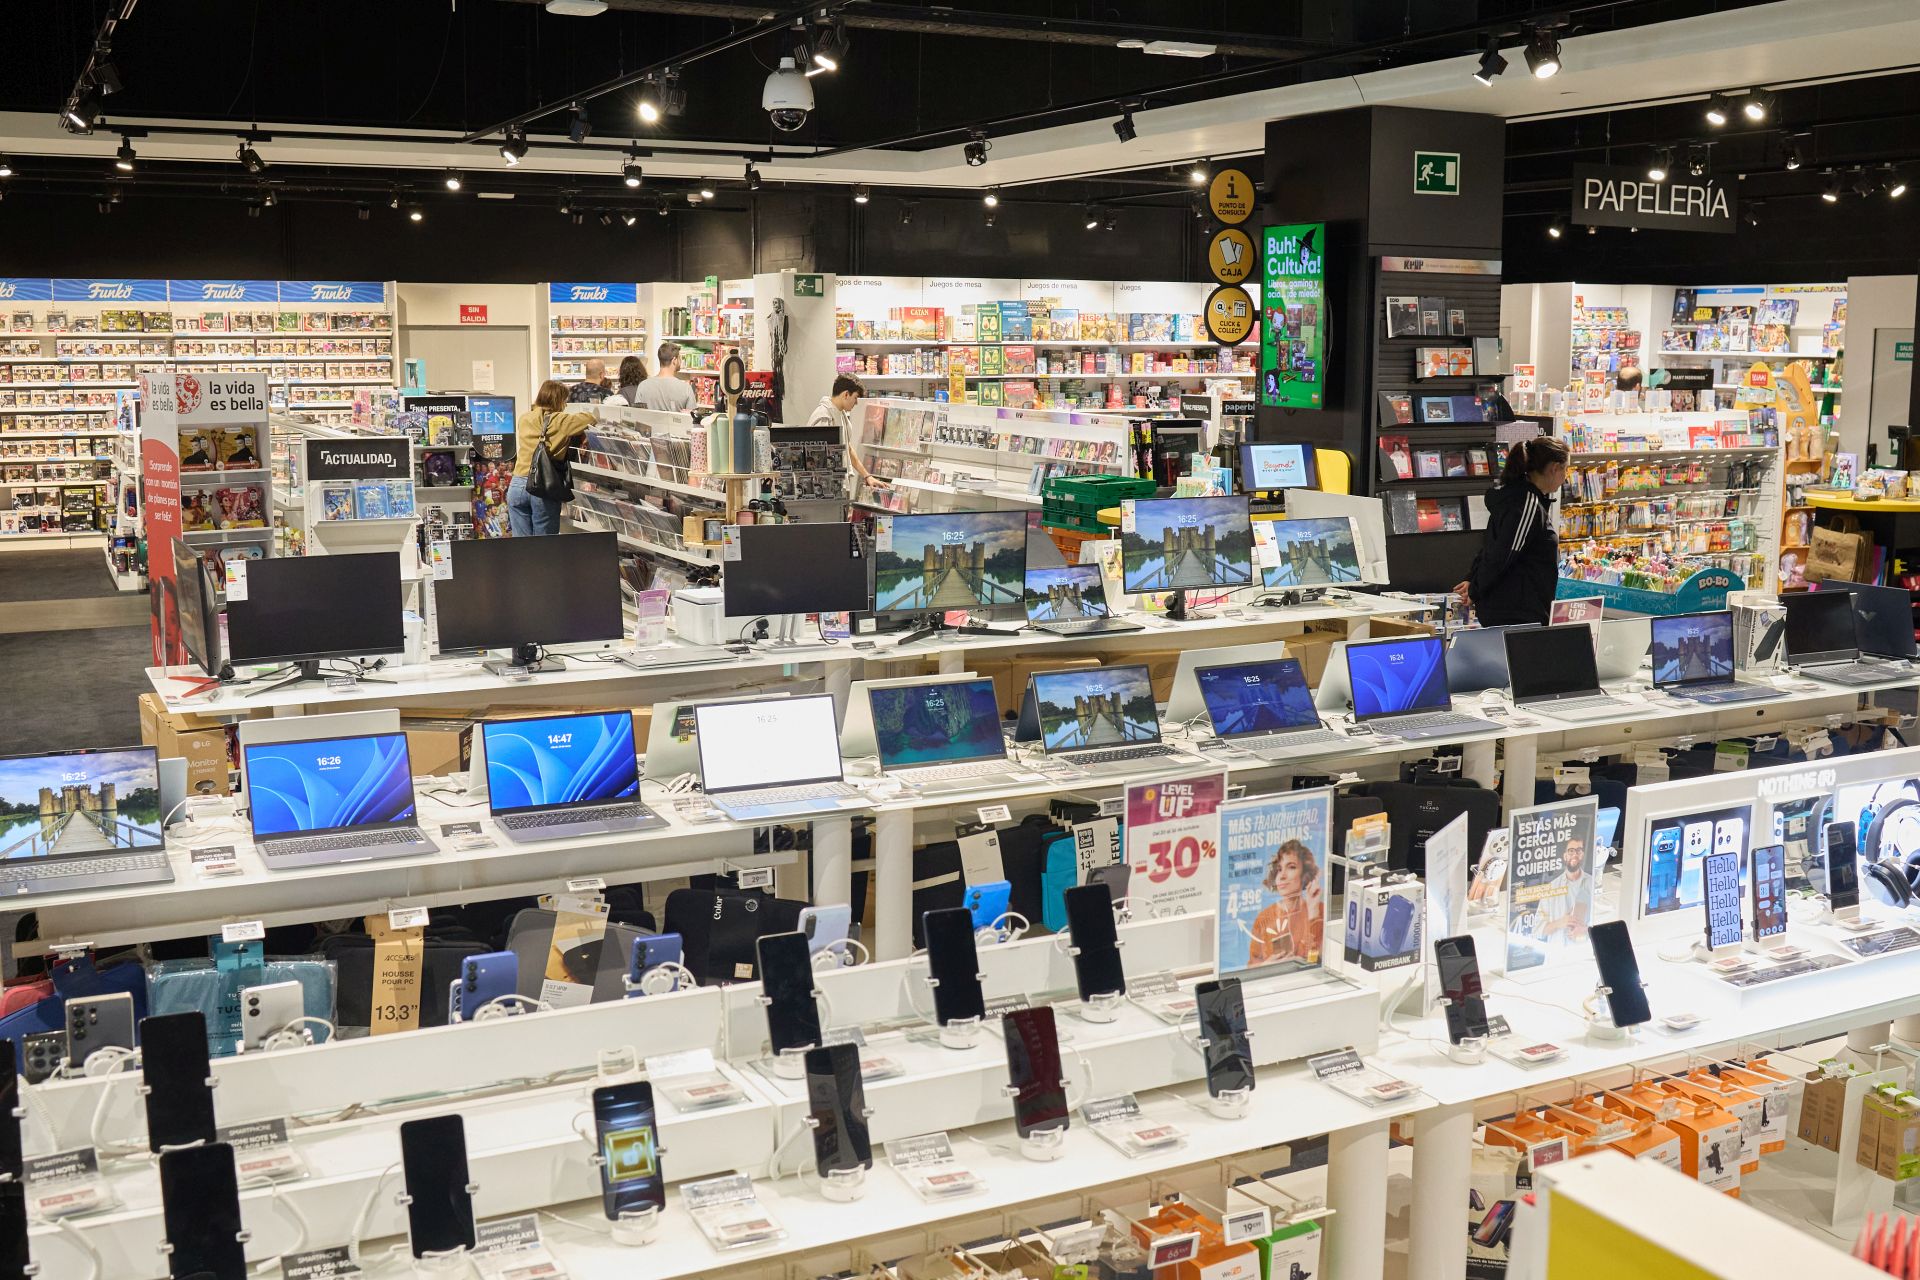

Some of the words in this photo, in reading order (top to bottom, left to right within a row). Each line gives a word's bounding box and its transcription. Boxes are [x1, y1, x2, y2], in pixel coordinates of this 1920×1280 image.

[1584, 178, 1729, 218] PAPELERÍA
[1268, 236, 1296, 254] Buh!
[1220, 268, 1242, 276] CAJA
[1268, 256, 1321, 275] Cultura!
[88, 282, 134, 299] Funko
[835, 280, 852, 288] egos
[929, 280, 950, 288] Juegos
[1027, 282, 1049, 291] Juegos
[1289, 280, 1312, 289] gaming
[1313, 280, 1318, 288] y
[202, 284, 246, 300] Funko
[311, 284, 353, 300] Funko
[570, 286, 608, 300] Funko
[152, 382, 157, 394] la
[158, 382, 170, 395] vida
[210, 381, 221, 394] la
[226, 381, 255, 394] vida
[152, 401, 159, 410] es
[160, 399, 174, 411] bella
[211, 400, 226, 410] es
[231, 397, 264, 410] bella
[429, 404, 458, 412] PRESENTA
[1660, 414, 1683, 422] Papelería
[324, 452, 392, 465] ACTUALIDAD
[1178, 514, 1196, 523] 16:25
[942, 532, 964, 540] 16:25
[1698, 576, 1729, 589] BO-BO
[1568, 609, 1587, 620] UP
[1244, 675, 1260, 683] 16:25
[926, 699, 944, 707] 16:25
[548, 734, 572, 744] 14:47
[186, 758, 219, 769] Monitor
[316, 756, 341, 766] 16:26
[61, 771, 87, 782] 16:25
[1161, 784, 1194, 795] LEVEL
[1758, 772, 1817, 797] NOTHING
[1159, 796, 1194, 817] UP
[1228, 816, 1252, 835] MÁS
[1254, 808, 1319, 831] TRANQUILIDAD,
[1518, 817, 1551, 836] ESTÁS
[1553, 813, 1577, 830] MÁS
[1228, 832, 1264, 852] MENOS
[1266, 826, 1312, 847] DRAMAS.
[1518, 833, 1555, 849] CERCA
[1557, 829, 1572, 841] DE
[1110, 831, 1121, 861] EEVE
[1079, 850, 1095, 859] 13"
[1135, 836, 1216, 883] -30%
[1517, 850, 1532, 863] LO
[1534, 845, 1557, 860] QUE
[1081, 860, 1095, 871] 14"
[1516, 858, 1562, 877] QUIERES
[1708, 857, 1736, 874] Hello
[1709, 875, 1737, 892] Hello
[713, 895, 723, 920] Color
[1710, 893, 1738, 910] Hello
[1712, 911, 1739, 928] Hello
[1712, 928, 1740, 946] Hello
[1374, 955, 1411, 969] POWERBANK
[217, 1006, 241, 1014] TUC
[1320, 1064, 1345, 1075] MOTOROLA
[1345, 1061, 1360, 1069] MOTO
[1090, 1111, 1109, 1120] XIAOMI
[228, 1123, 272, 1137] SMARTPHONE
[33, 1154, 80, 1169] SMARTPHONE
[30, 1170, 52, 1179] REDMI
[53, 1167, 76, 1176] NOTE
[475, 1237, 506, 1249] AMSUNG
[507, 1230, 535, 1242] GALAXY
[297, 1251, 343, 1263] SMARTPHONE
[288, 1265, 312, 1277] REDMI
